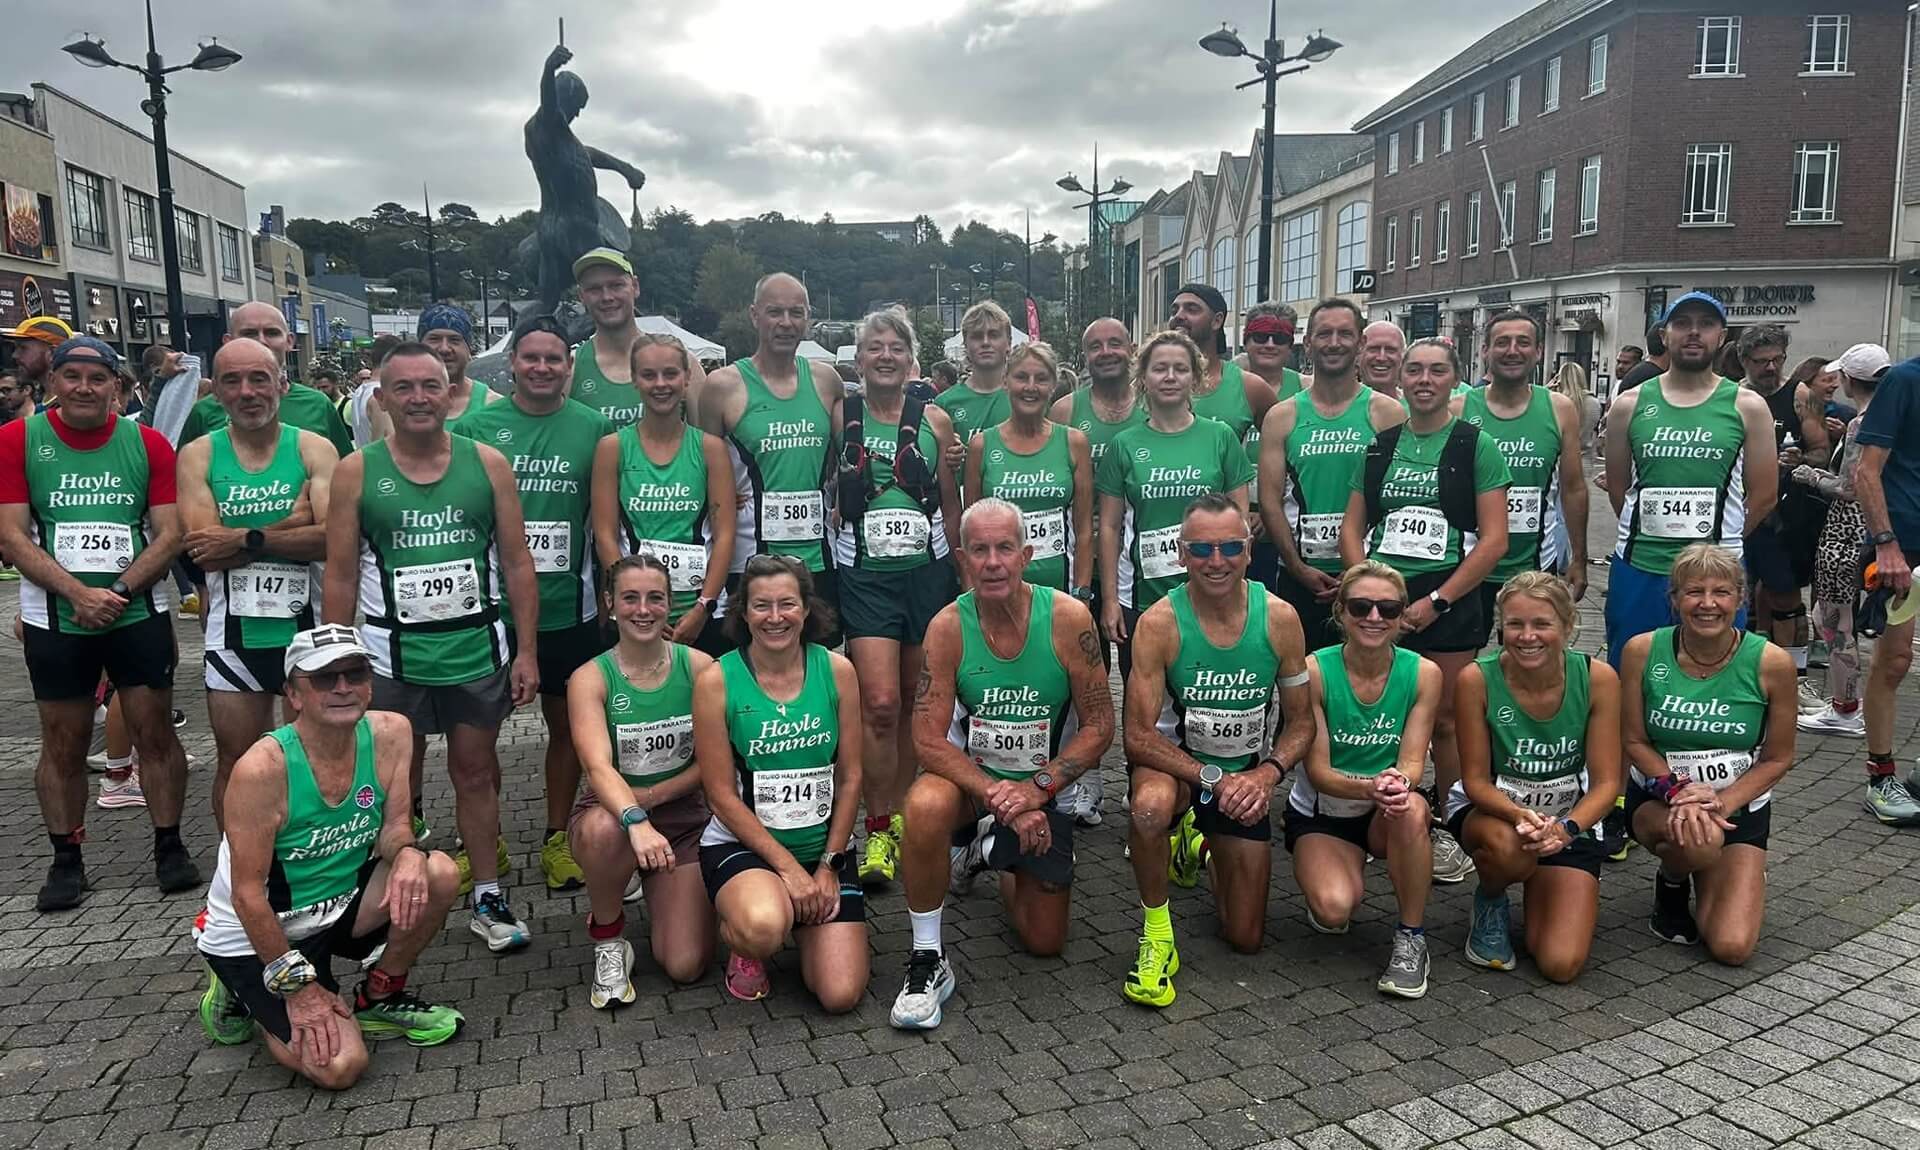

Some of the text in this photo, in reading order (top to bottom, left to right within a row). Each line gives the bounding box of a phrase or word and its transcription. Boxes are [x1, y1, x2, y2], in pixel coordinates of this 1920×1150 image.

[1355, 275, 1375, 289] JD
[1723, 305, 1797, 316] THERSPOON
[600, 403, 644, 422] Hayl
[768, 419, 815, 437] Hayle
[1309, 427, 1361, 443] Hayle
[1652, 427, 1713, 445] Hayle
[760, 435, 823, 453] Runners
[864, 436, 898, 450] Hay
[1642, 443, 1724, 459] Runners
[512, 455, 570, 475] Hayle
[1505, 455, 1545, 468] nners
[59, 472, 121, 492] Hayle
[1000, 470, 1055, 487] Hayle
[1148, 465, 1201, 483] Hayle
[1393, 467, 1439, 484] Hayl
[226, 480, 291, 501] Hayle
[516, 476, 578, 494] unners
[639, 482, 690, 500] Hayle
[992, 486, 1066, 499] Runners
[1140, 484, 1211, 499] Runners
[1381, 483, 1439, 498] Runne
[48, 491, 135, 508] Runners
[218, 498, 295, 517] Runner
[628, 497, 699, 511] Runners
[1507, 499, 1523, 513] 55
[784, 505, 808, 519] 580
[1662, 501, 1691, 516] 544
[401, 505, 464, 530] Hayle
[886, 521, 910, 535] 582
[1320, 526, 1341, 541] 24
[1400, 518, 1427, 536] 540
[81, 535, 111, 550] 256
[391, 527, 476, 549] Runners
[524, 535, 550, 550] 278
[1159, 538, 1179, 554] 44
[438, 564, 465, 572] MARATH
[255, 576, 284, 593] 147
[422, 577, 453, 597] 299
[1193, 669, 1257, 688] Hayle
[983, 686, 1039, 704] Hayle
[1182, 686, 1268, 701] Runners
[975, 703, 1051, 717] Runners
[1212, 711, 1229, 719] HALF
[1660, 695, 1731, 719] Hayle
[644, 725, 660, 733] HALF
[661, 719, 692, 730] MARATHO
[759, 713, 821, 739] Hayle
[1011, 723, 1038, 731] MARATH
[1211, 723, 1243, 738] 568
[1649, 710, 1747, 735] Runners
[645, 734, 675, 752] 300
[747, 731, 831, 757] Runners
[994, 735, 1024, 750] 504
[1515, 736, 1578, 759] Hayle
[1691, 753, 1710, 761] HALF
[1697, 762, 1729, 783] 108
[1523, 781, 1541, 789] HALF
[1542, 777, 1575, 788] MARATHON
[782, 784, 812, 803] 214
[1522, 792, 1554, 806] 412
